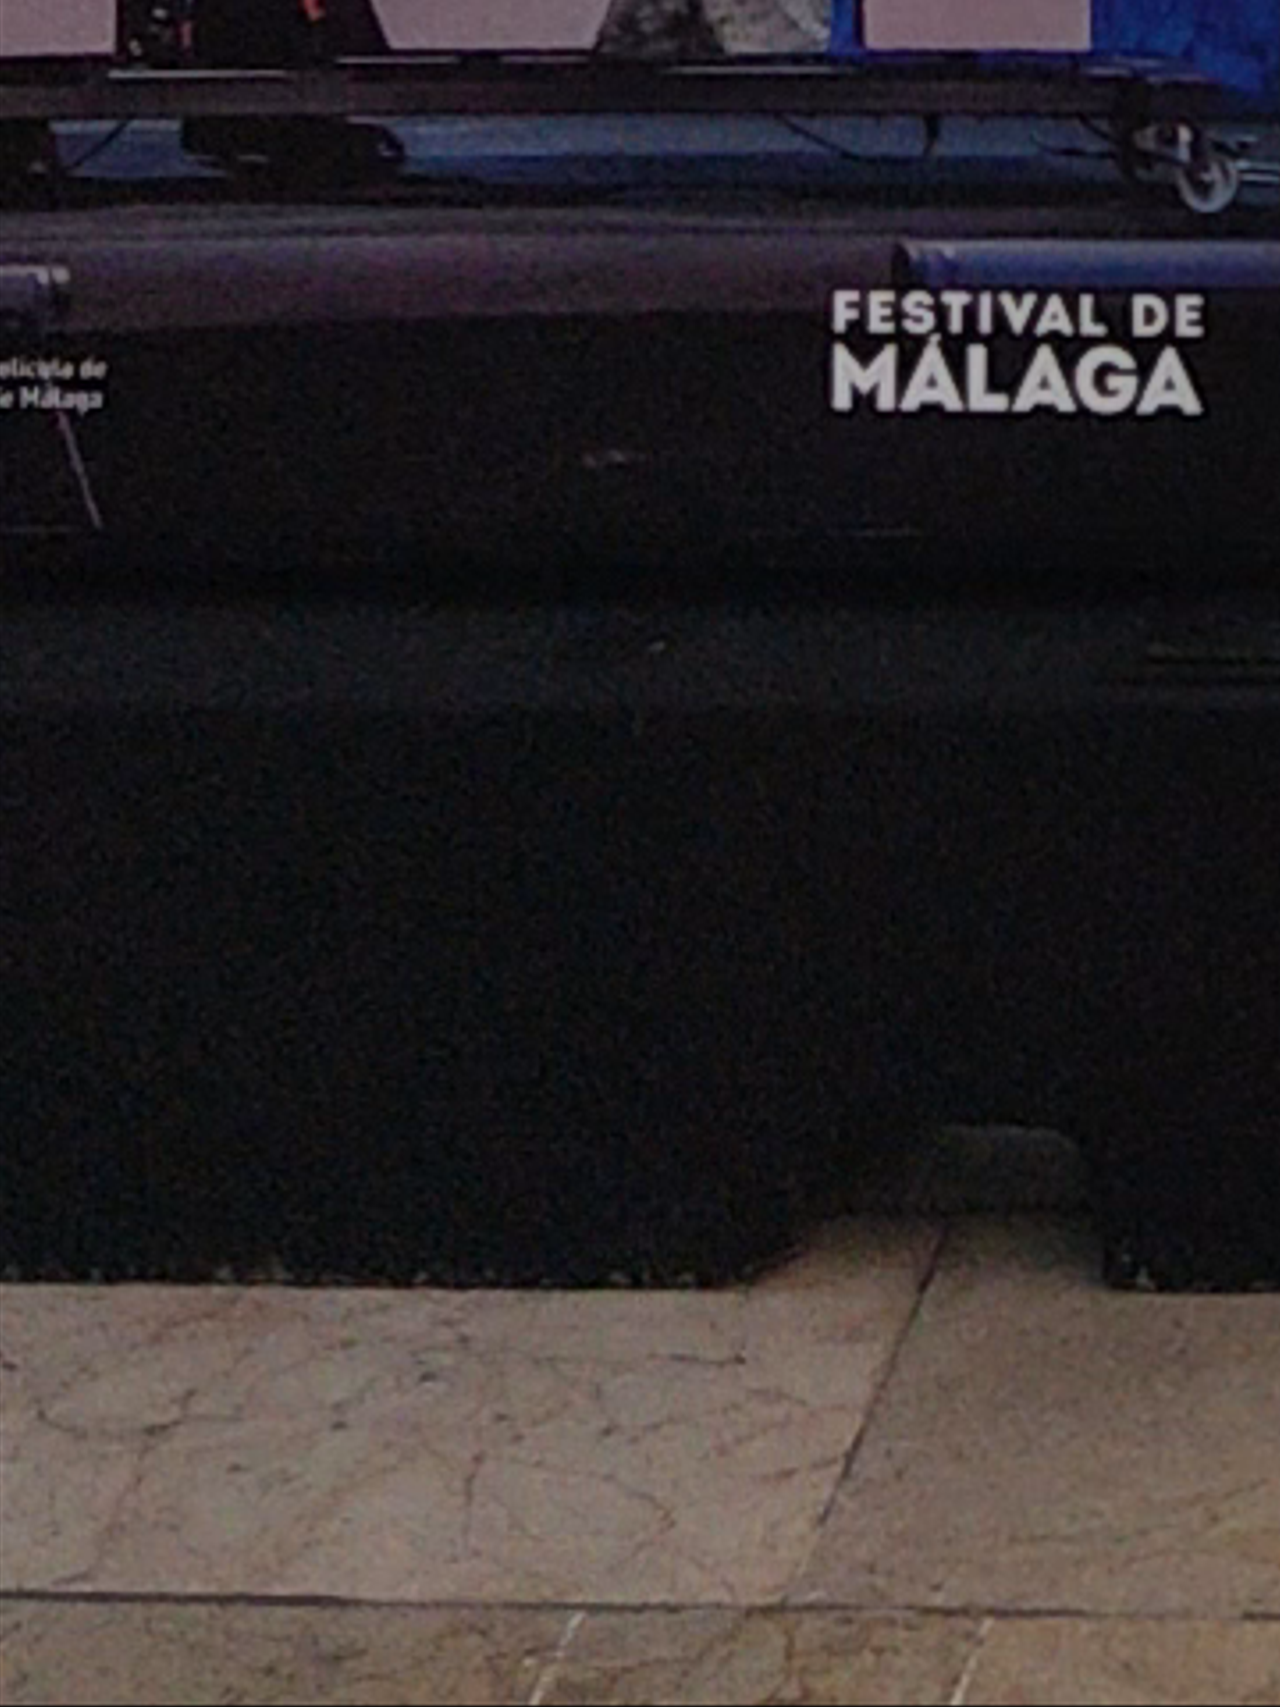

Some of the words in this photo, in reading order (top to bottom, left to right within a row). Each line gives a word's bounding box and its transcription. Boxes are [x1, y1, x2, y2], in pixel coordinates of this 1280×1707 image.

[832, 289, 1107, 336] FESTIVAL
[1131, 293, 1204, 338] DE
[80, 356, 108, 380] de
[831, 332, 1204, 416] MÁLAGA
